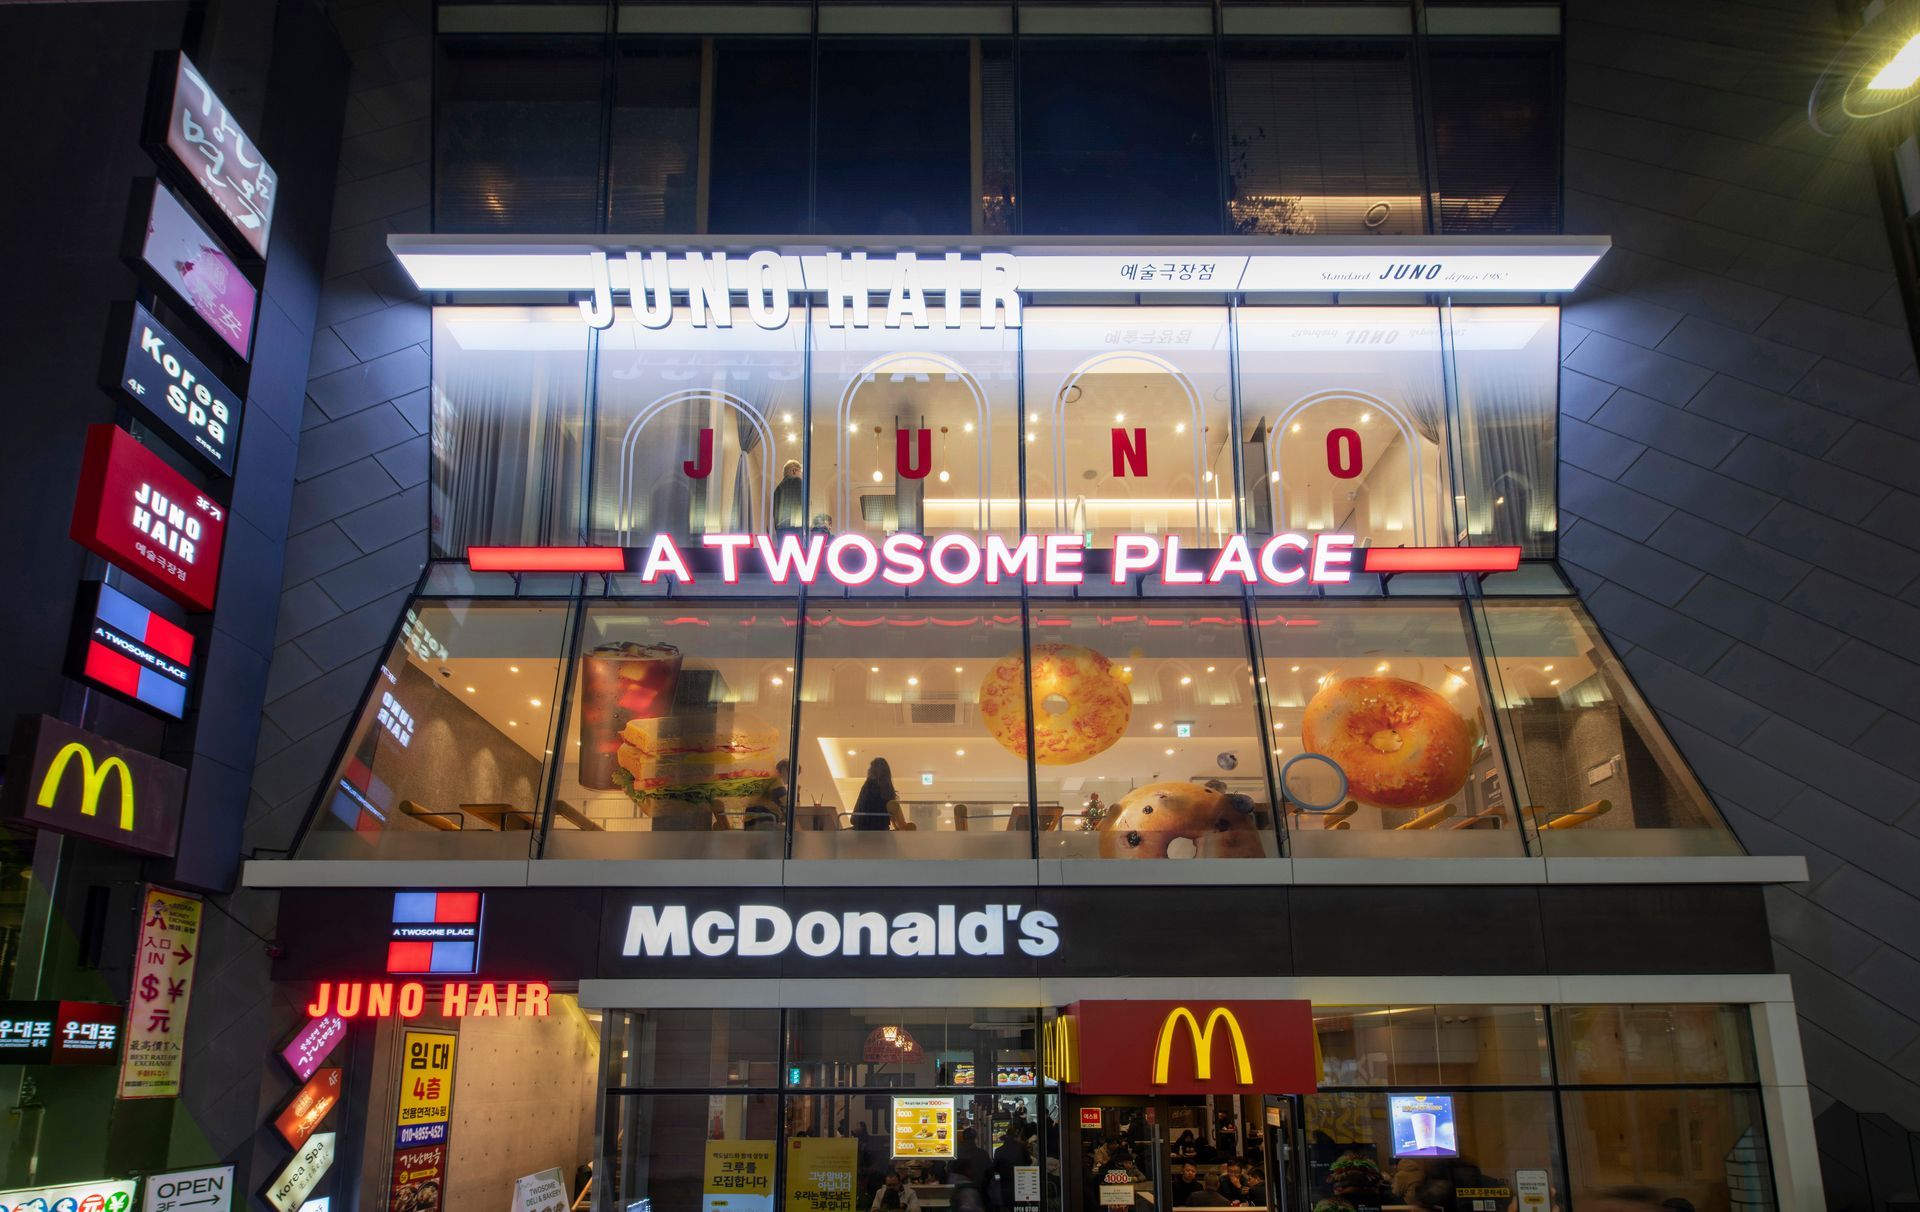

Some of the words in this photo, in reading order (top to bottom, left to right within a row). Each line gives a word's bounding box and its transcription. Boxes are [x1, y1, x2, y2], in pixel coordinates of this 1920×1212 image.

[1120, 262, 1216, 281] 예술극장점
[1320, 271, 1371, 280] Standard
[1379, 264, 1442, 280] JUNO
[1445, 271, 1478, 282] depuis
[579, 250, 789, 328] JUNO
[826, 251, 1022, 328] HAIR
[127, 378, 146, 395] 4F
[141, 326, 229, 425] Korea
[166, 384, 225, 445] Spa
[134, 482, 201, 541] JUNO
[132, 504, 195, 565] HAIR
[134, 542, 187, 582] 예술극장점
[641, 533, 695, 585] A
[703, 533, 1086, 585] TWOSOME
[1113, 533, 1356, 585] PLACE
[95, 627, 104, 637] A
[105, 631, 155, 664] TWOSOME
[155, 659, 187, 680] PLACE
[393, 928, 400, 936] A
[401, 928, 445, 936] TWOSOME
[446, 928, 475, 936] PLACE
[622, 904, 1060, 957] McDonald's
[144, 936, 171, 949] 入口
[148, 952, 165, 965] IN
[140, 974, 160, 1002] $
[308, 982, 424, 1018] JUNO
[442, 982, 549, 1018] HAIR
[0, 1020, 51, 1038] 우대포
[62, 1021, 117, 1040] 우대포
[148, 1009, 170, 1033] 元
[411, 1042, 449, 1070] 임대
[328, 1071, 338, 1086] 4F
[413, 1077, 441, 1100] 4층
[400, 1147, 441, 1169] 강남면옥
[721, 1162, 756, 1174] 크루를
[276, 1166, 305, 1201] Korea
[305, 1142, 324, 1164] Spa
[712, 1176, 768, 1188] 모집합니다
[157, 1177, 223, 1199] OPEN
[794, 1191, 819, 1200] 우리는
[157, 1202, 174, 1212] 3F
[810, 1201, 851, 1211] 크루입니다
